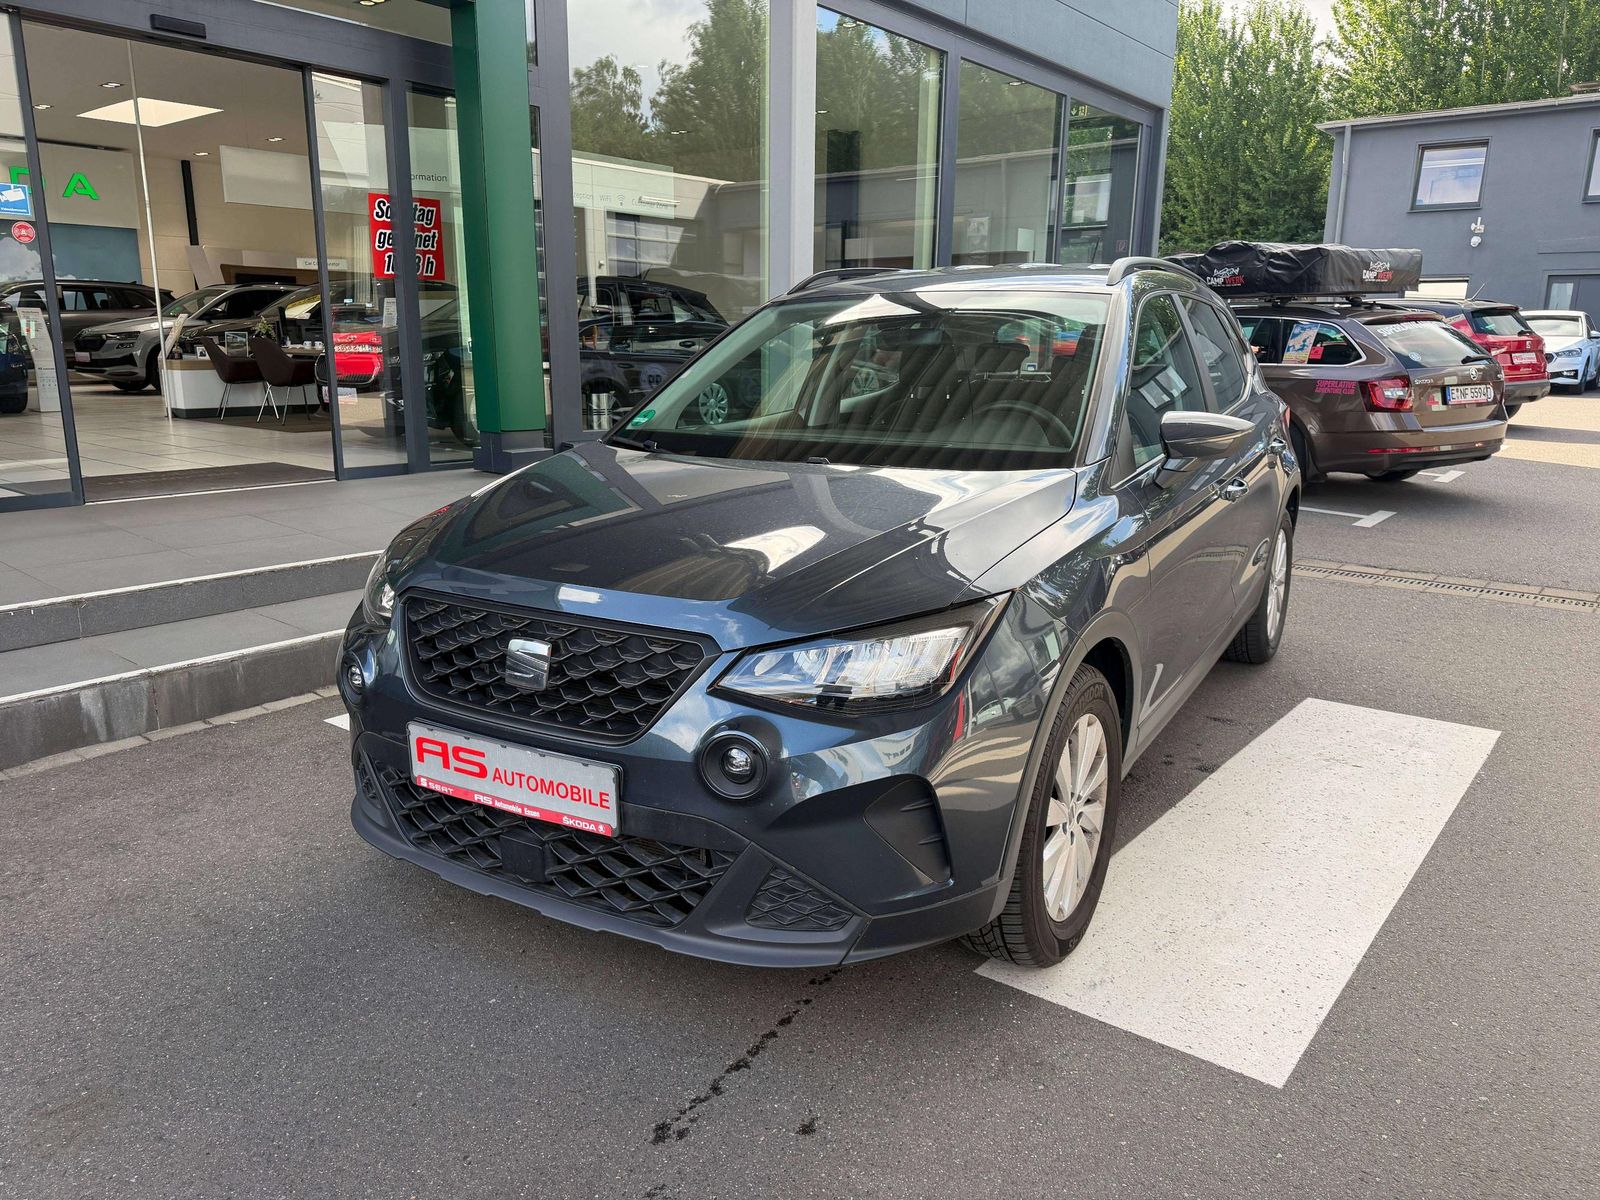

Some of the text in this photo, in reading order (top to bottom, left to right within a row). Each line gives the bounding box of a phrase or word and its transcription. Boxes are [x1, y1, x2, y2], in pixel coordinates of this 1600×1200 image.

[410, 173, 448, 182] ormation
[374, 198, 436, 228] Sotag
[375, 228, 438, 250] genet
[423, 254, 436, 276] h
[1206, 275, 1245, 285] CAMP WERK
[416, 736, 611, 810] AS AUTOMOBILE
[428, 781, 454, 795] SEAT
[474, 793, 493, 806] AS
[494, 799, 522, 814] Automobile
[562, 815, 597, 832] ŠKODA
